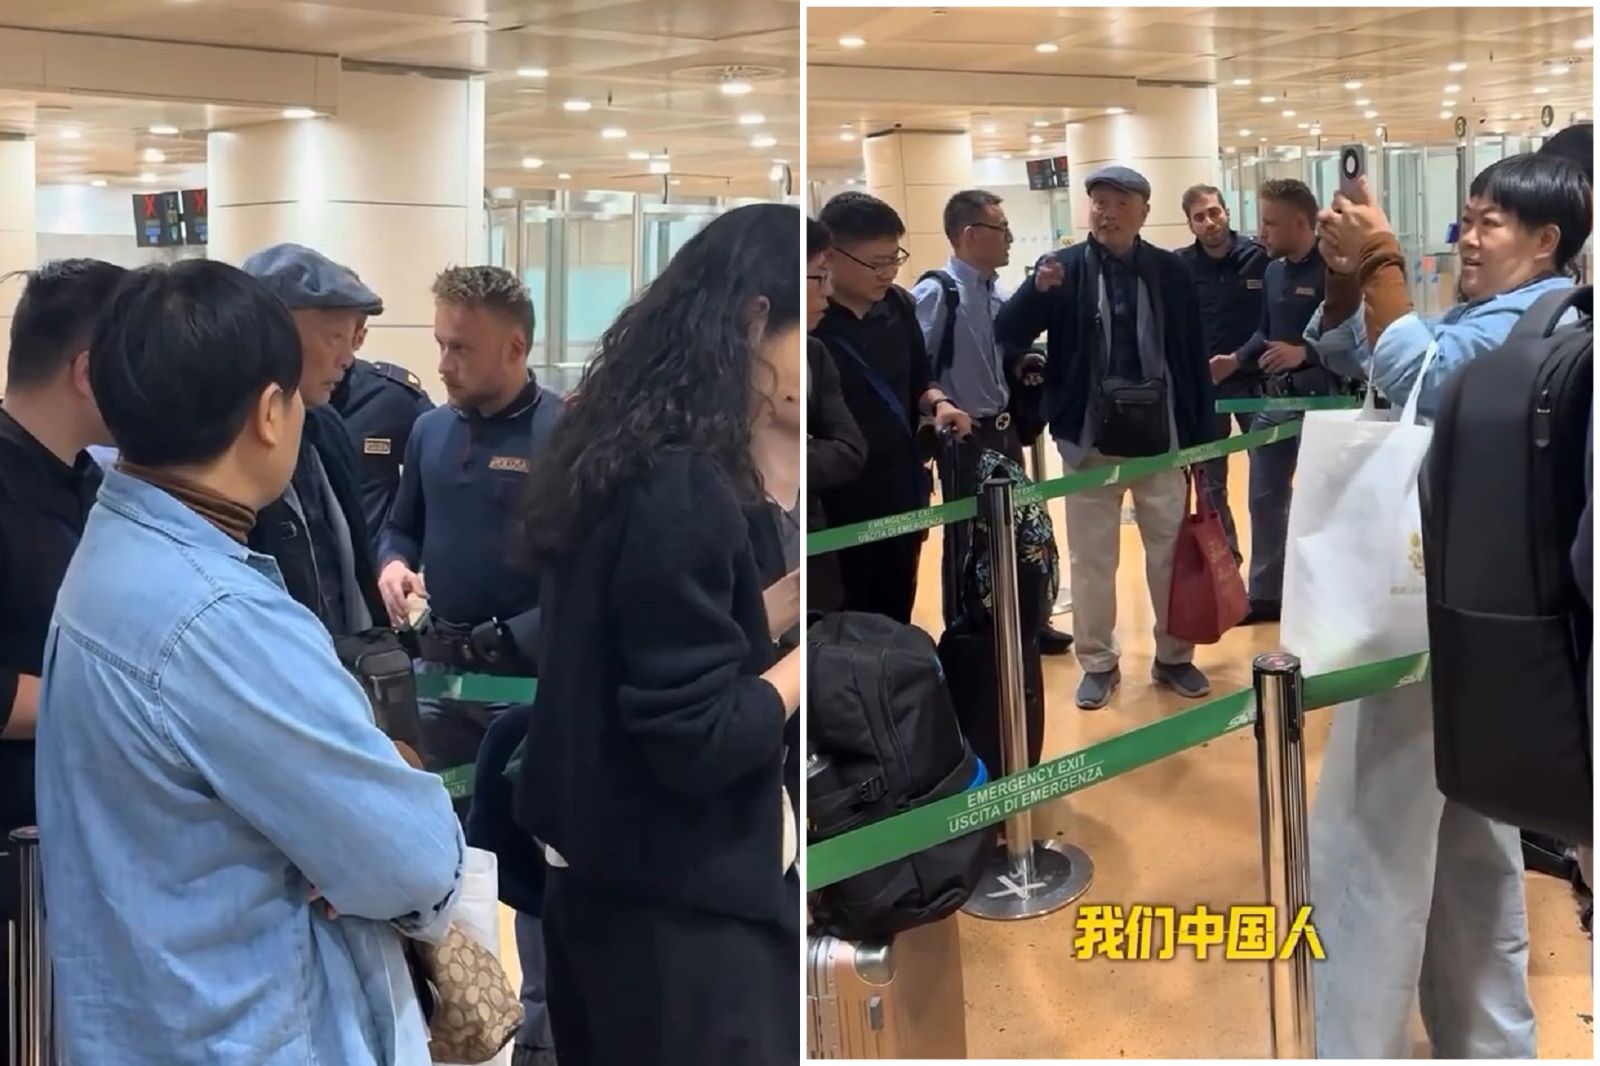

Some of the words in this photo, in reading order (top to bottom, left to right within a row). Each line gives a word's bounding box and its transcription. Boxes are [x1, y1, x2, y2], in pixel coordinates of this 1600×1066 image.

[949, 805, 1001, 833] USCITA
[1004, 798, 1018, 813] DI
[1021, 766, 1104, 807] EMERGENZA
[967, 766, 1055, 808] EMERGENCY
[1057, 753, 1087, 775] EXIT
